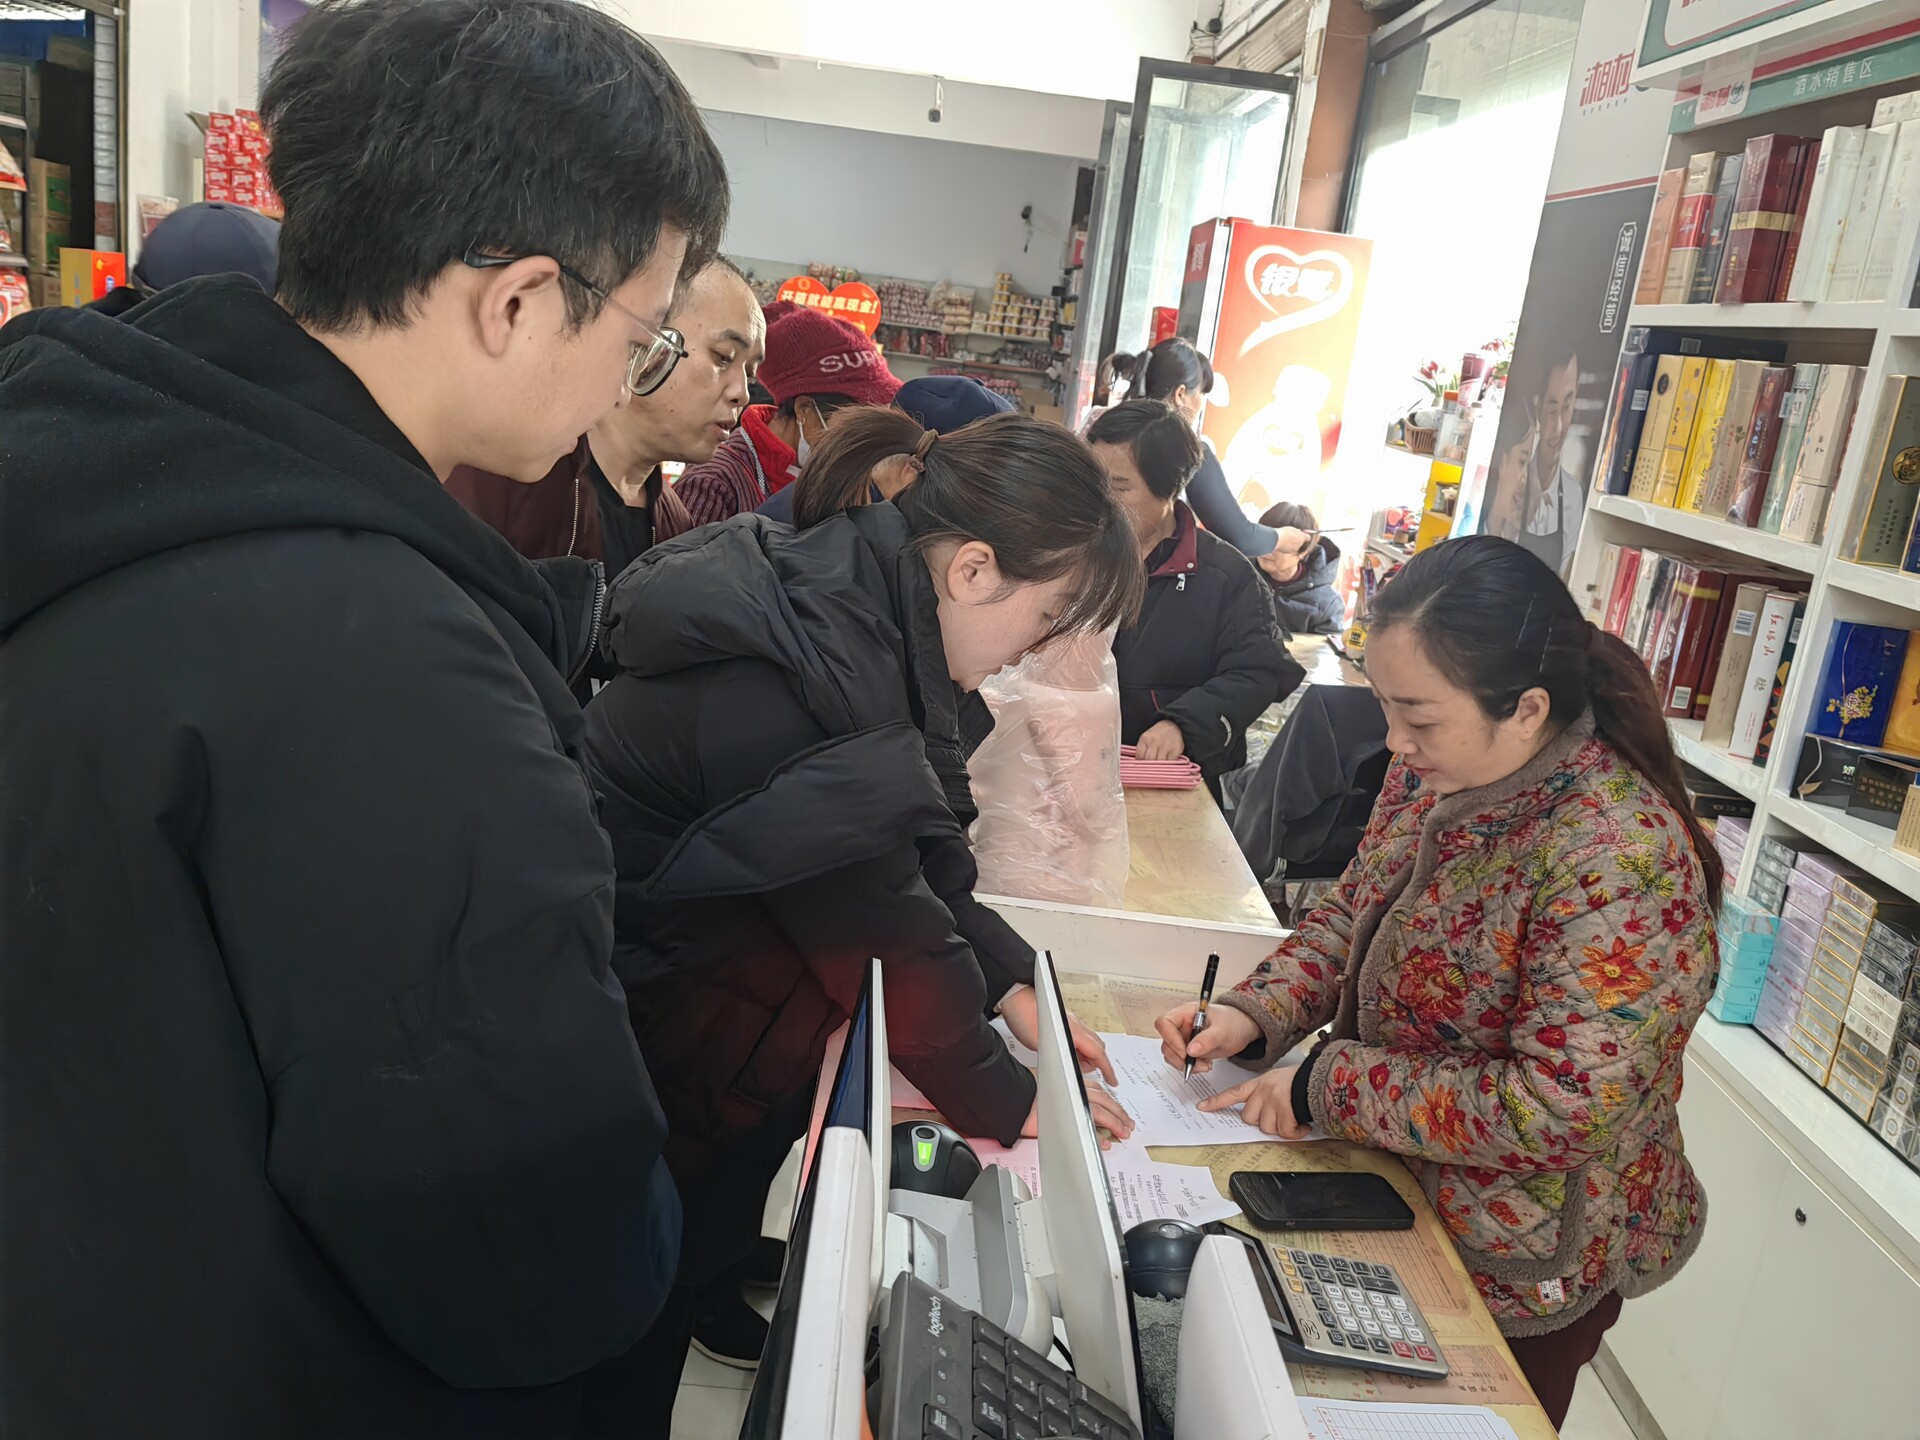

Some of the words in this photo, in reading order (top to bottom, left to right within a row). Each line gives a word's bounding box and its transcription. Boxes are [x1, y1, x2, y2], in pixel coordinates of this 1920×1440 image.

[1793, 56, 1876, 96] 酒水销售区
[927, 1296, 944, 1338] logitech
